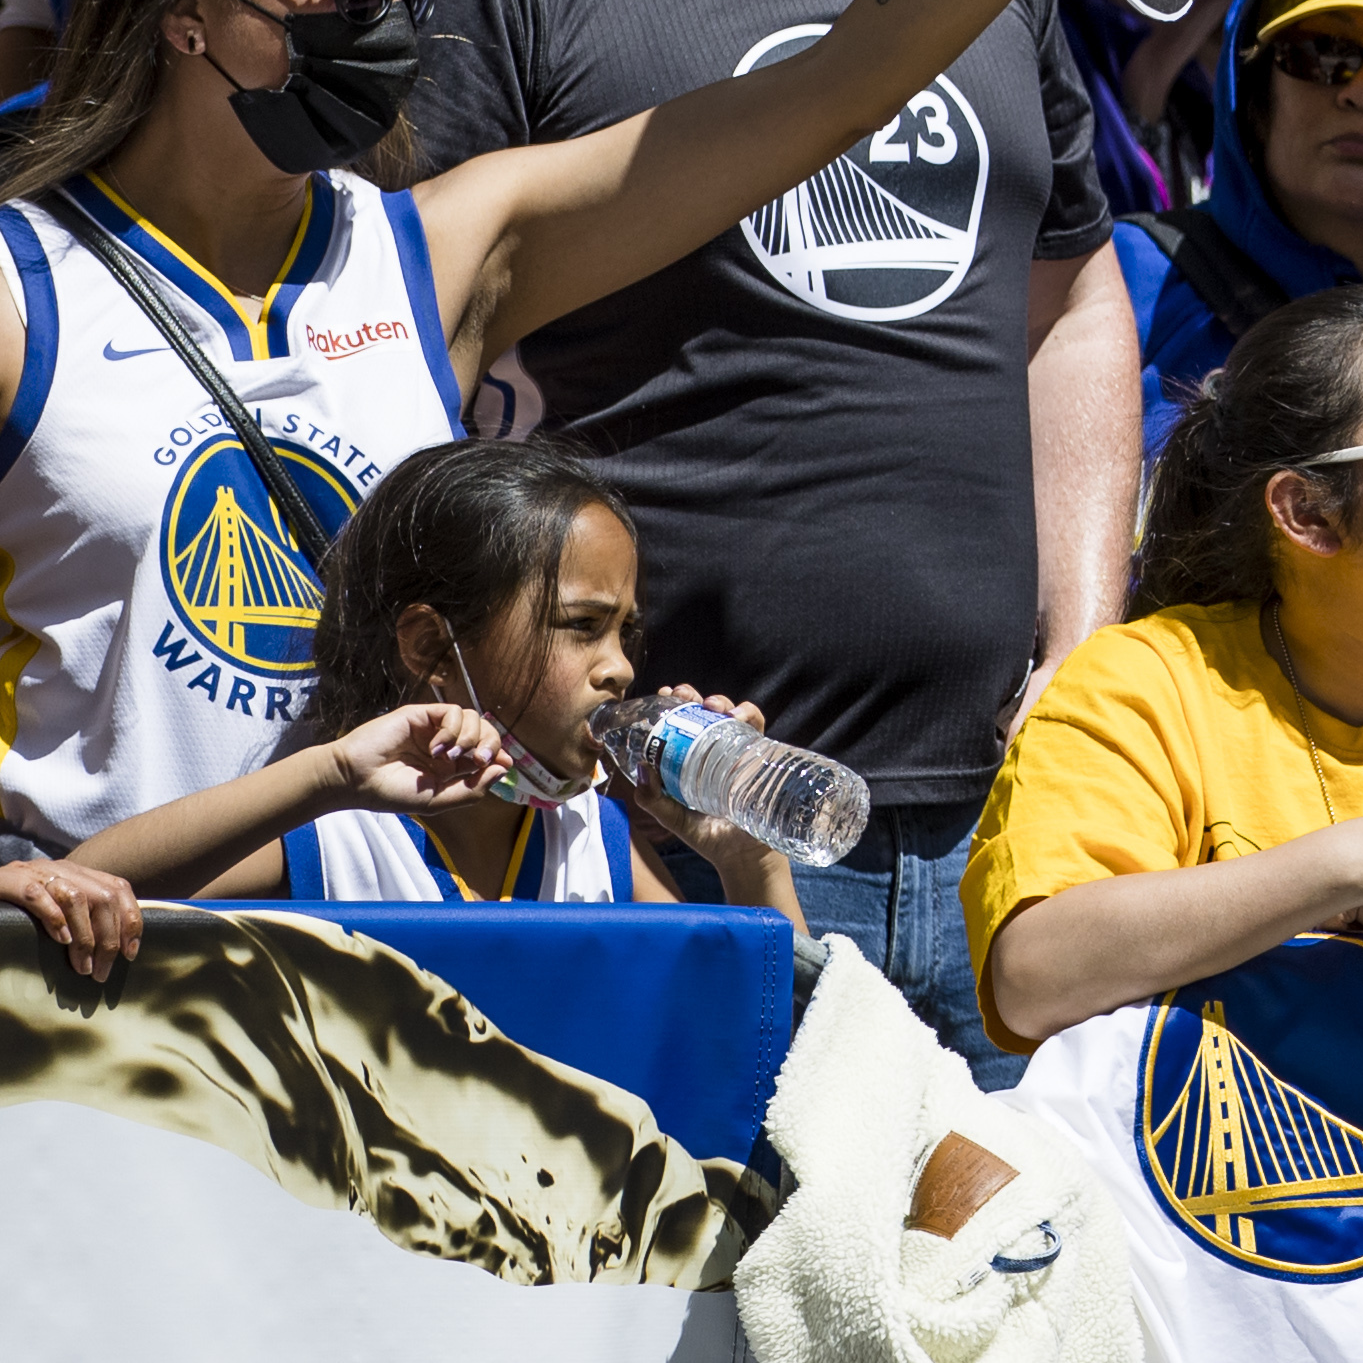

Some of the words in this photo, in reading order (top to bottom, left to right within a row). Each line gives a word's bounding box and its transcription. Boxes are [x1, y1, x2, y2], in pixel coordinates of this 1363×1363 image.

[869, 89, 958, 166] 23
[305, 321, 409, 354] Rakuten
[153, 407, 262, 466] GOLD
[282, 413, 383, 487] STATE
